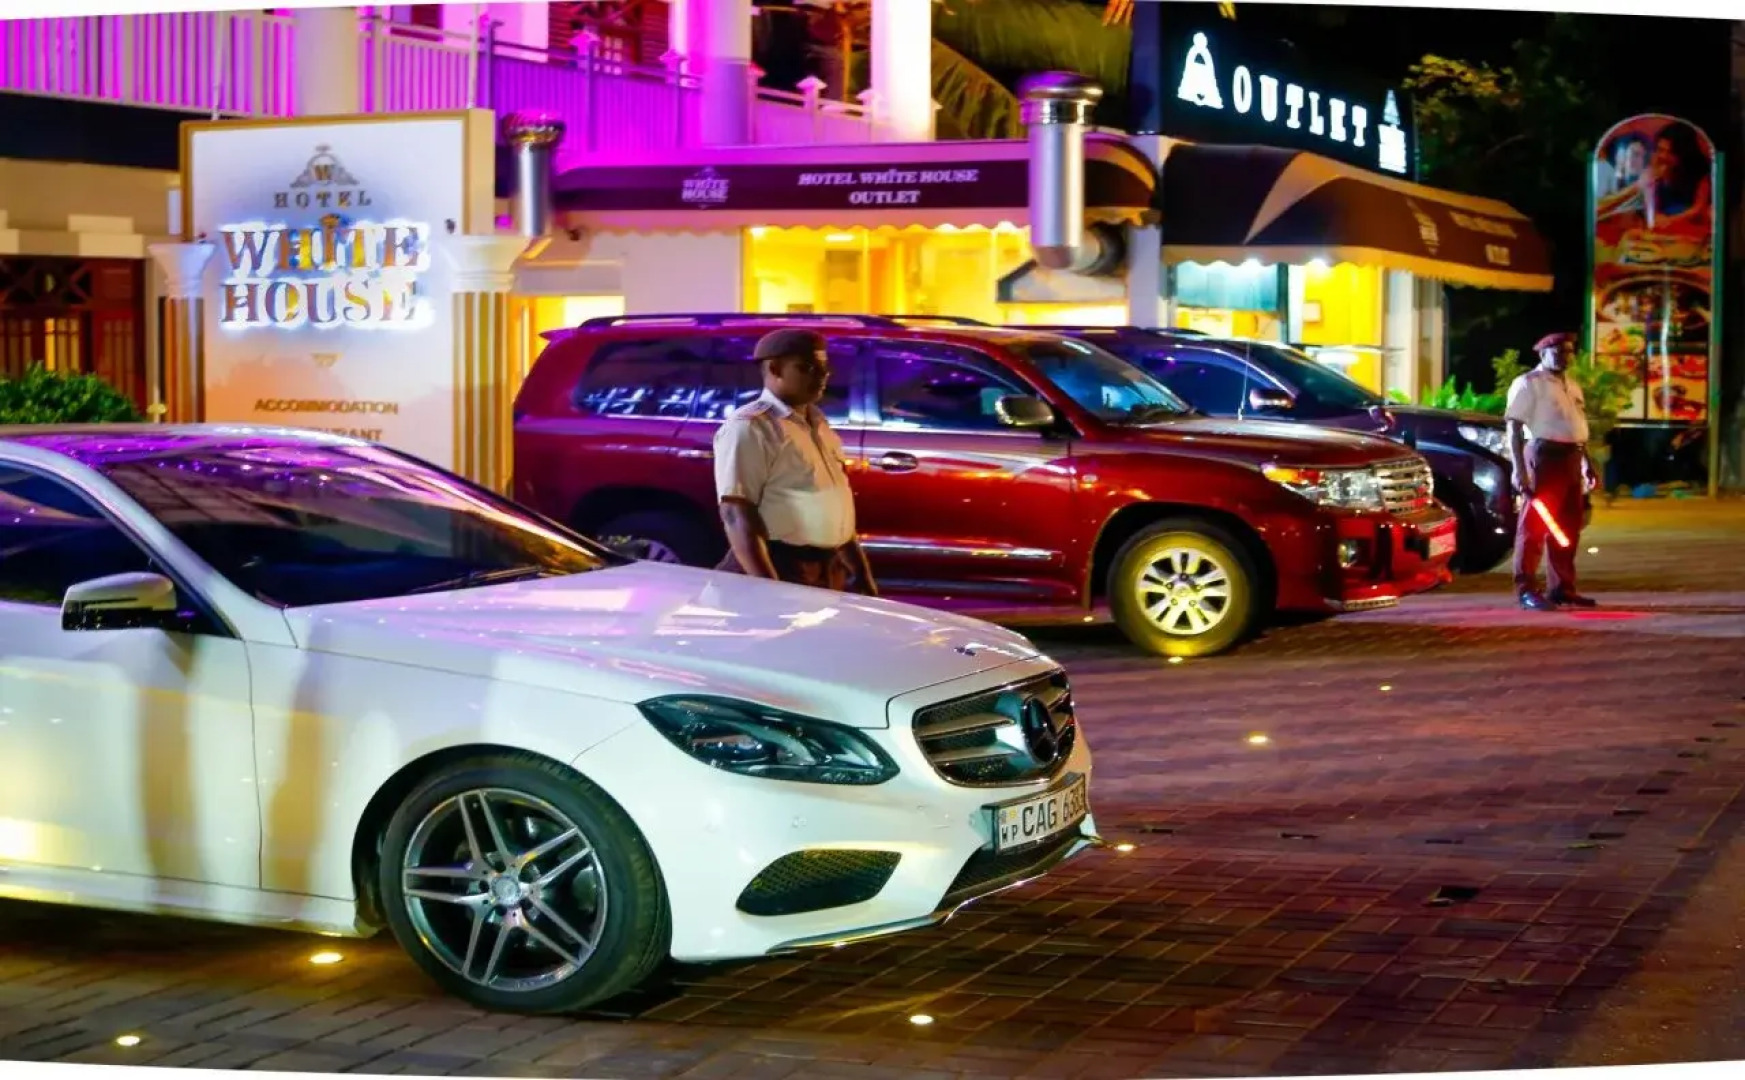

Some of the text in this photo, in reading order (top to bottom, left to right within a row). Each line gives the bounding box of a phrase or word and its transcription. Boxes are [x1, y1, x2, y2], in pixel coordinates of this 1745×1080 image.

[1233, 65, 1367, 147] OUTLET
[798, 168, 979, 186] HOTEL WHITE HOUSE
[274, 190, 372, 209] HOTEL
[849, 191, 921, 204] OUTLET
[221, 213, 419, 271] WHITE
[220, 280, 418, 324] HOUSE
[1022, 798, 1057, 837] CAG
